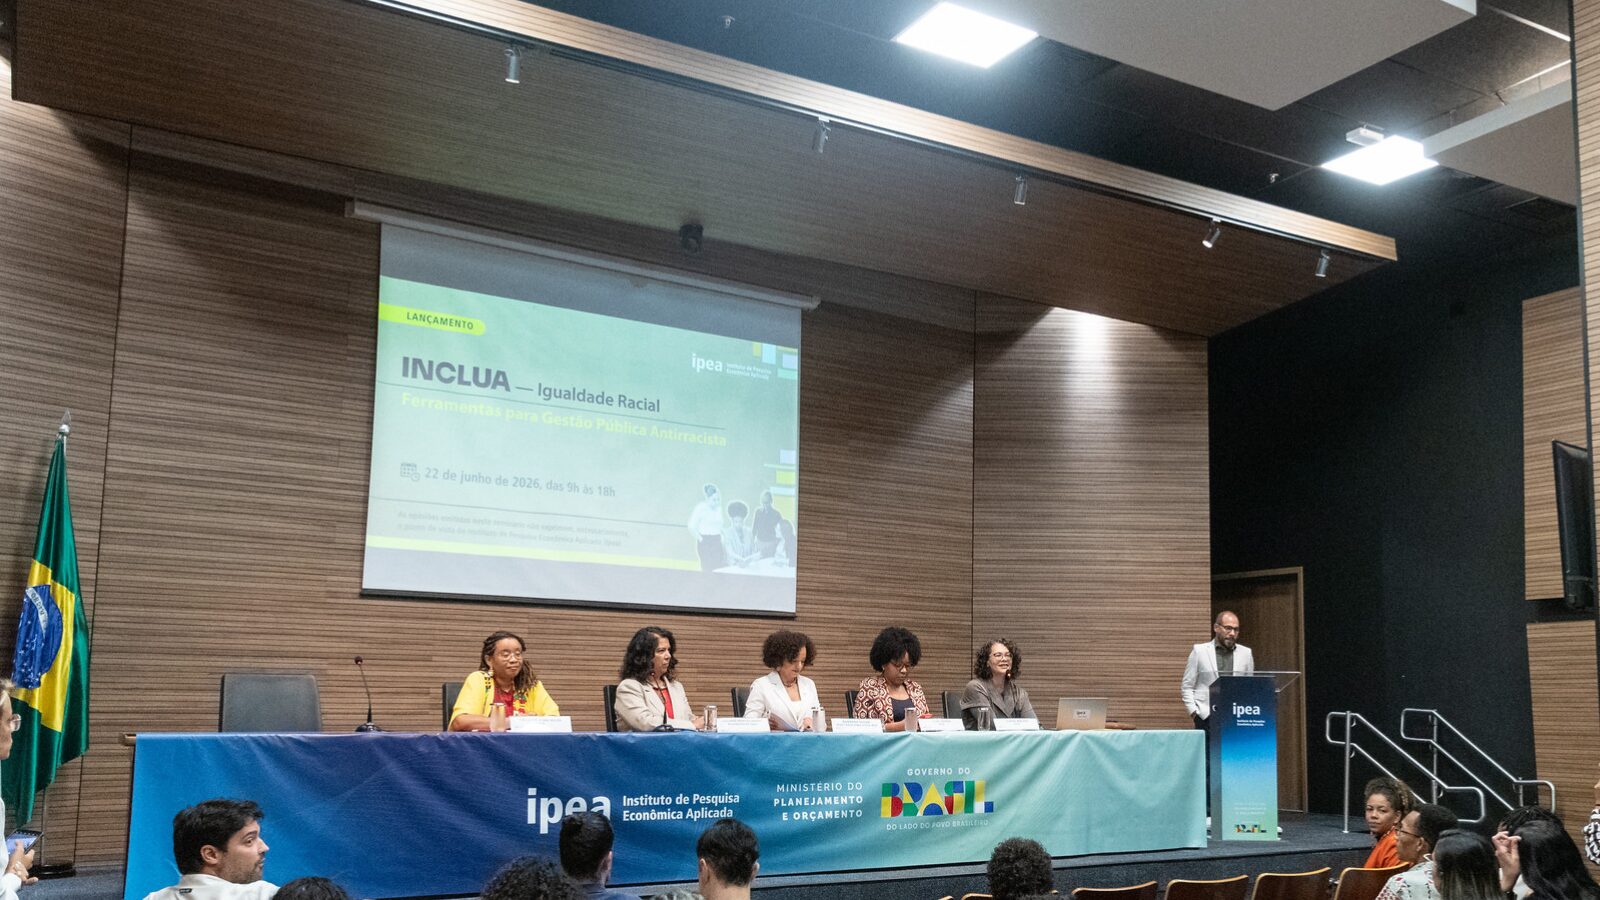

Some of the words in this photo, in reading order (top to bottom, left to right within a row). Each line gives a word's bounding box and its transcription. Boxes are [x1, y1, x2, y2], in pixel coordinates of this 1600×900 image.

[406, 311, 474, 330] LANÇAMENTO
[691, 353, 723, 373] ipea
[402, 356, 511, 392] INCLUA
[538, 383, 614, 406] Igualdade
[618, 394, 661, 413] Racial
[401, 392, 500, 417] Ferramentas
[504, 408, 538, 423] para
[542, 410, 593, 430] Gestão
[596, 417, 648, 436] Pública
[650, 425, 727, 447] Antirracista
[424, 466, 439, 480] 22
[442, 469, 457, 481] de
[460, 470, 492, 486] junho
[494, 475, 509, 487] de
[512, 476, 543, 490] 2026,
[546, 479, 564, 492] das
[567, 480, 580, 494] 9h
[598, 485, 616, 498] 18h
[1232, 702, 1261, 718] ipea
[907, 767, 953, 776] GOVERNO
[958, 767, 971, 775] DO
[776, 781, 843, 793] MINISTÉRIO
[847, 781, 863, 791] DO
[622, 794, 672, 807] Instituto
[675, 793, 690, 805] de
[692, 792, 740, 806] Pesquisa
[773, 795, 864, 807] PLANEJAMENTO
[881, 779, 994, 818] BRASIL
[527, 787, 612, 834] ipea
[622, 808, 683, 822] Econômica
[686, 806, 734, 821] Aplicada
[782, 812, 789, 821] E
[793, 809, 863, 822] ORÇAMENTO
[886, 823, 897, 831] DO
[900, 822, 919, 830] LADO
[920, 821, 930, 829] DO
